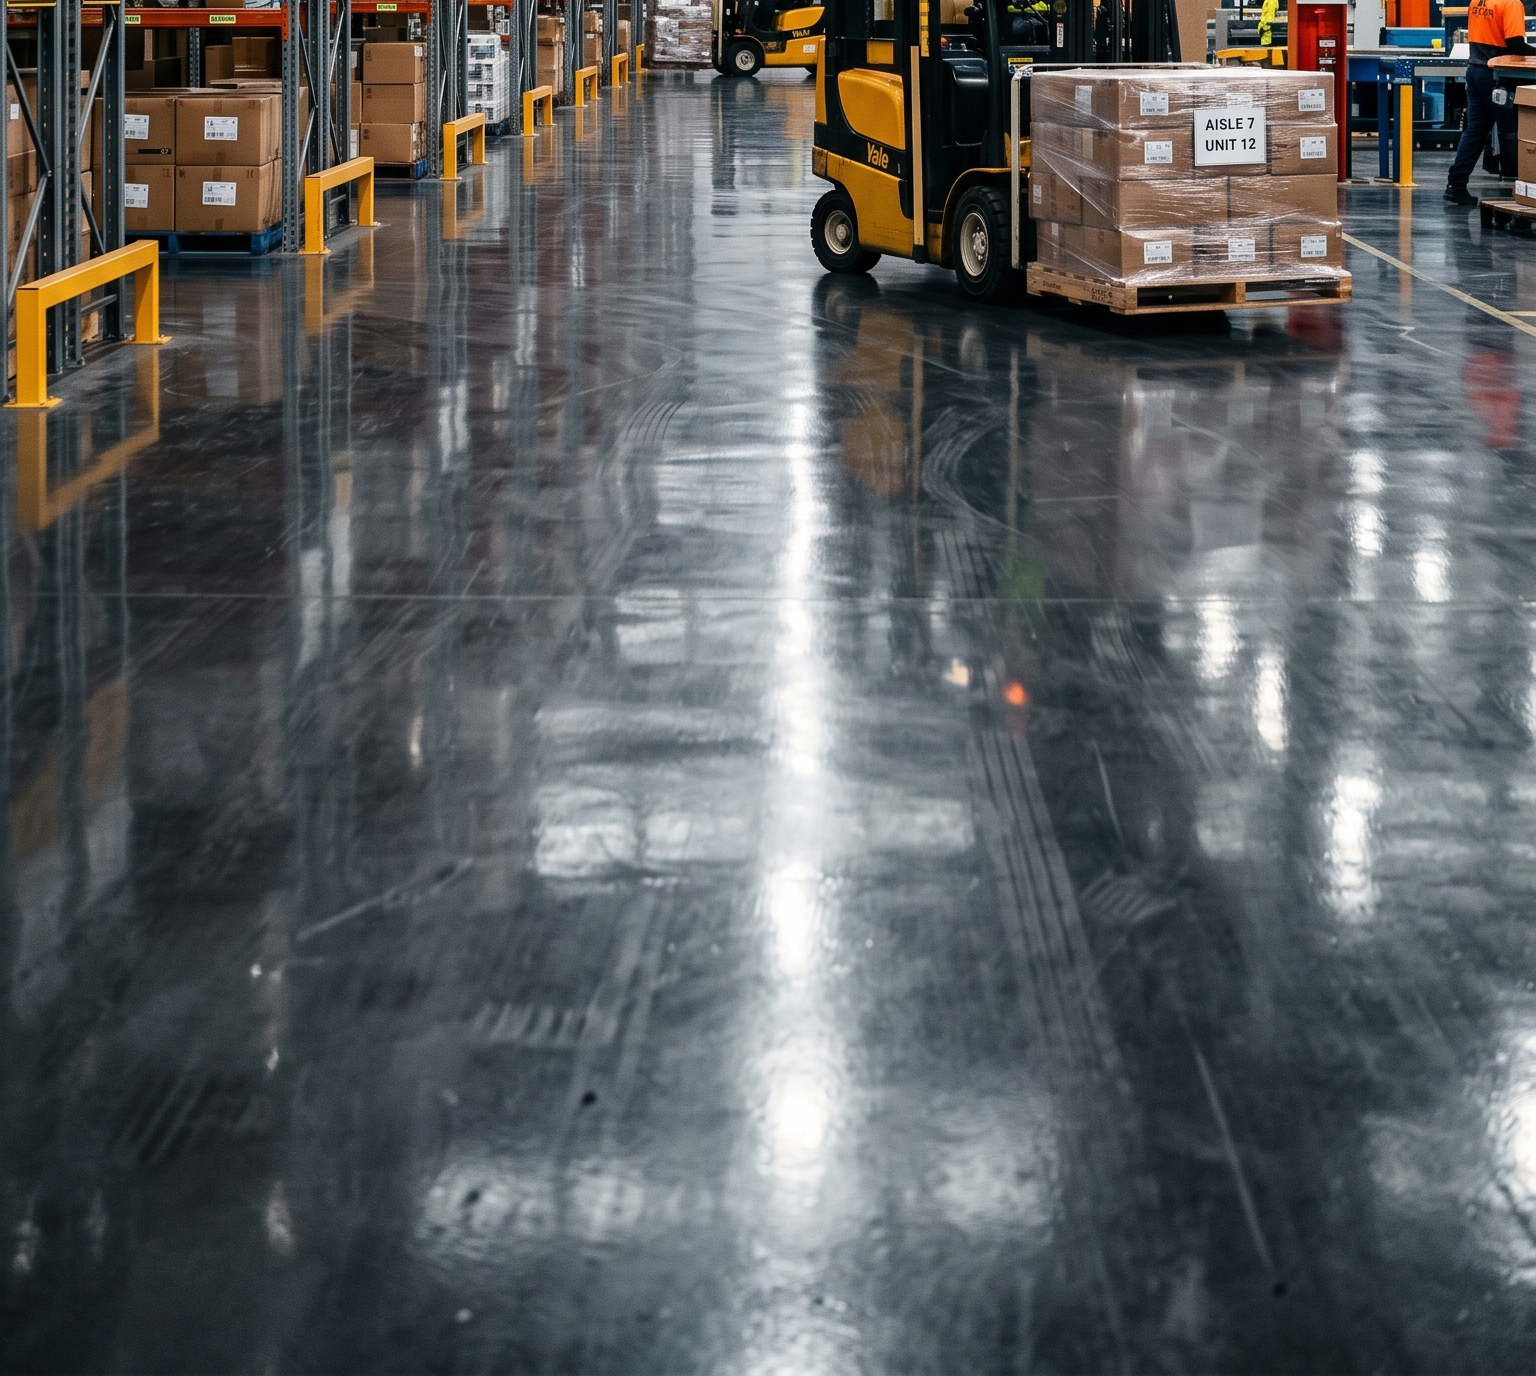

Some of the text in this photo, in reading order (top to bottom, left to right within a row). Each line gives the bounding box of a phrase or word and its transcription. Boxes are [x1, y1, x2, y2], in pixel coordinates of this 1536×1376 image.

[1205, 117, 1255, 131] AISLE 7
[1205, 137, 1257, 152] UNIT 12
[867, 141, 889, 169] Yale
